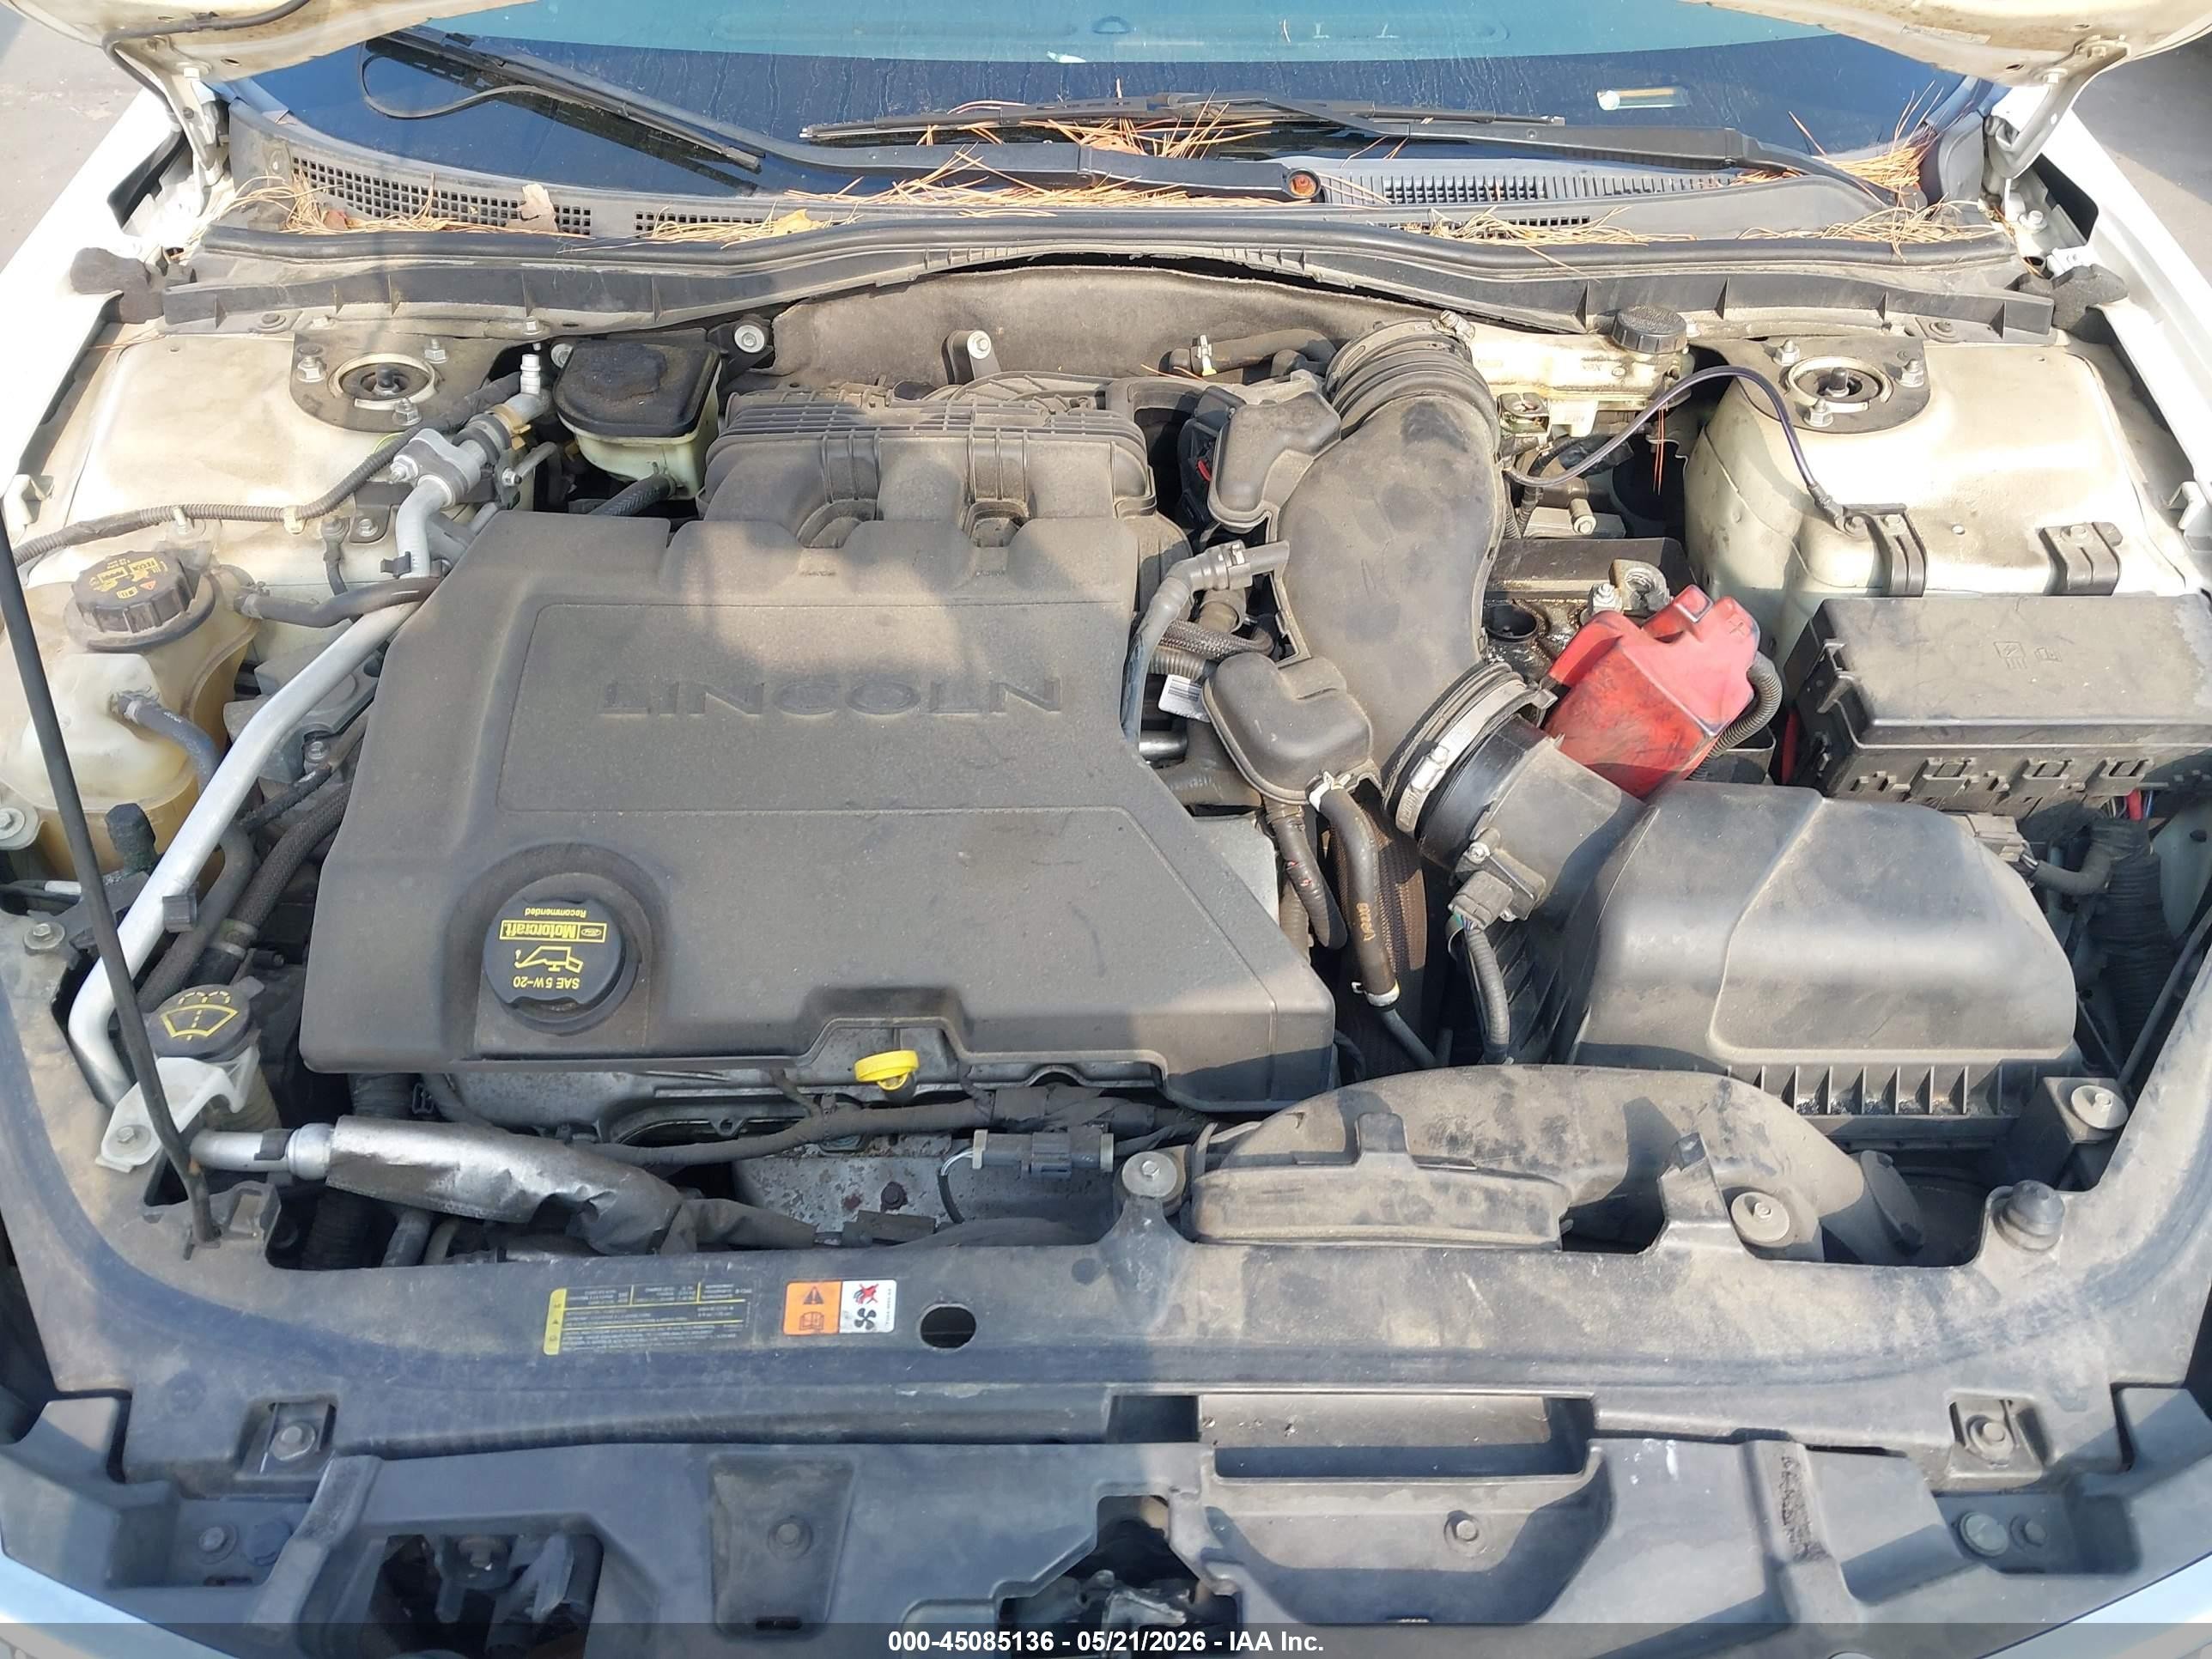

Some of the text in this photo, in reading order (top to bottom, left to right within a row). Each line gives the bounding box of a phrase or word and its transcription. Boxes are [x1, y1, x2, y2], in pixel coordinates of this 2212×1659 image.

[599, 680, 1061, 715] LINCOLN
[524, 907, 586, 918] Recommended
[504, 922, 578, 939] Motorcraft
[556, 977, 580, 989] SAE
